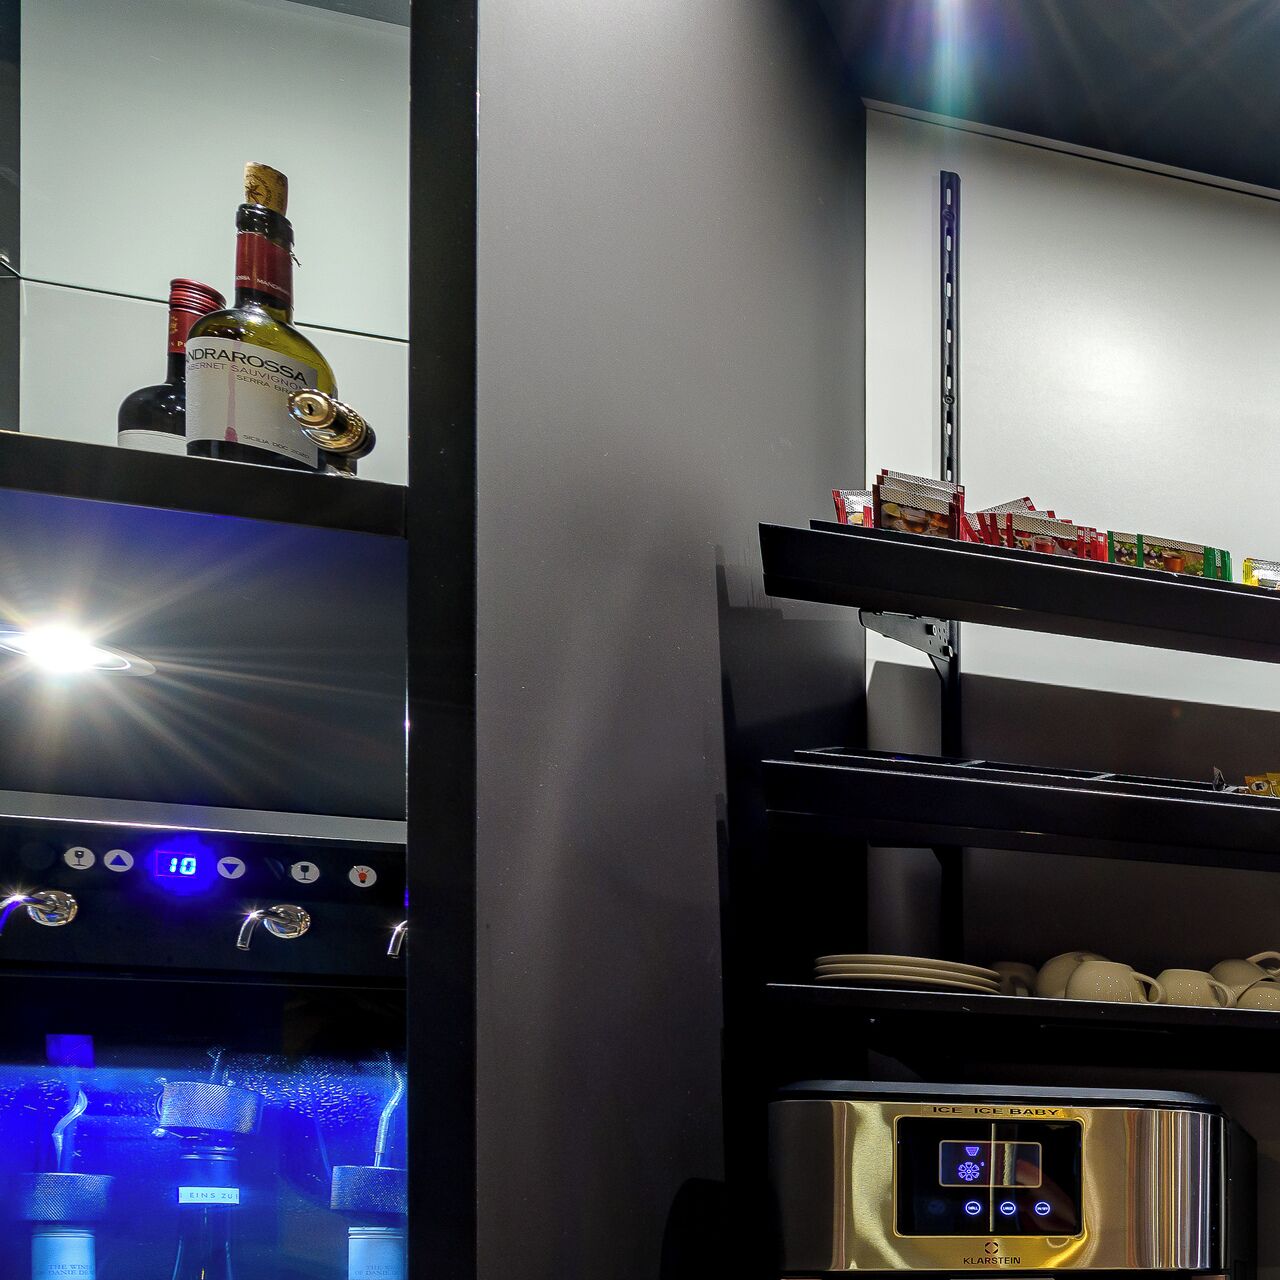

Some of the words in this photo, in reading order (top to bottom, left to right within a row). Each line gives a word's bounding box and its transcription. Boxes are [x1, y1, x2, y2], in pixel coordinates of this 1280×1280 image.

[186, 348, 309, 387] NDRAROSSA
[236, 374, 270, 388] SERRA
[243, 434, 270, 445] SICILIA
[170, 858, 197, 875] 10
[933, 1106, 963, 1114] ICE
[1010, 1108, 1059, 1116] BABY
[963, 1257, 1021, 1265] KLARSTEIN
